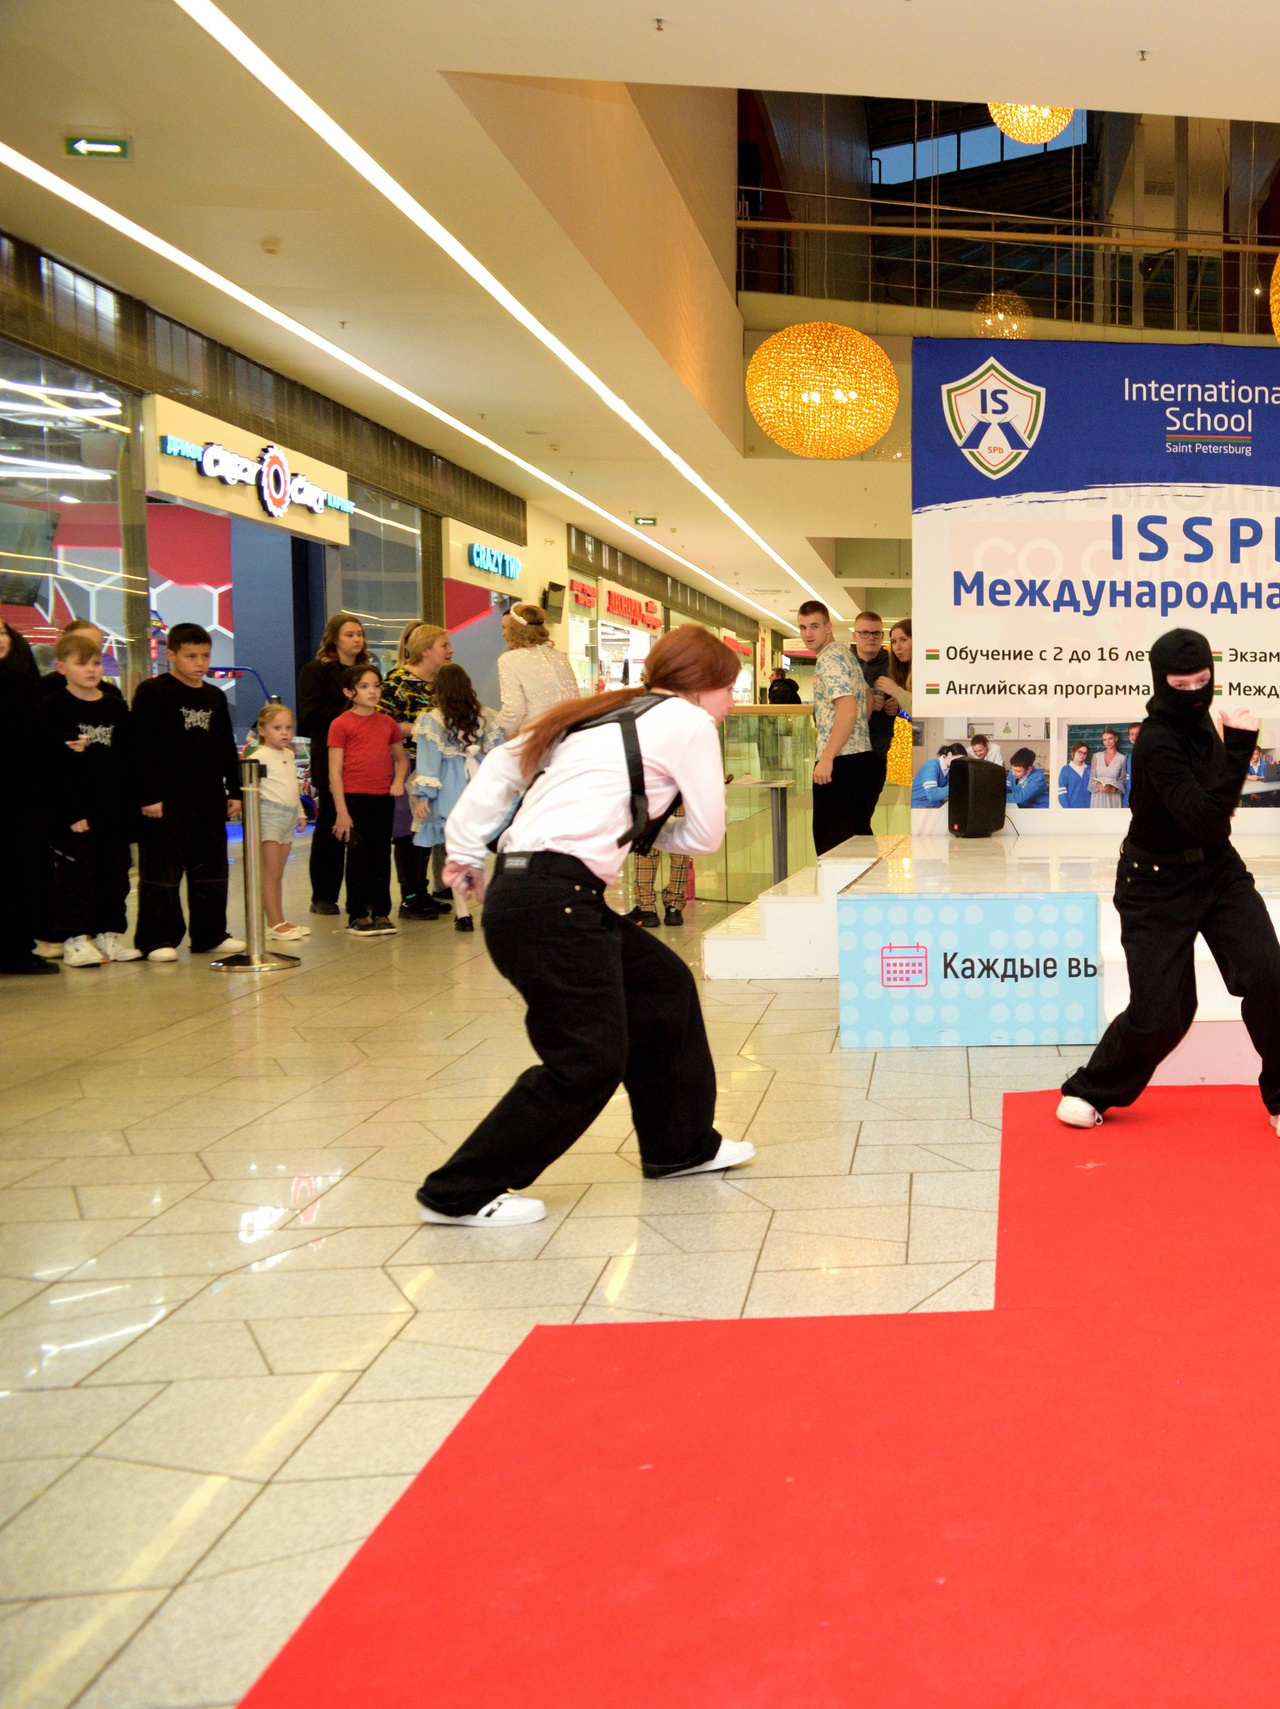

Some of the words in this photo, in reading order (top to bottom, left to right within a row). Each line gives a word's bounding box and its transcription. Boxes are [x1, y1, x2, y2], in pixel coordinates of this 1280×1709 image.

[980, 388, 1009, 415] IS
[1165, 407, 1252, 433] School
[987, 446, 1004, 454] SPb
[1165, 443, 1193, 454] Saint
[1195, 443, 1252, 457] Petersburg
[472, 543, 502, 573] CRAZY
[946, 646, 1034, 663] Обучение
[1039, 650, 1047, 660] с
[1053, 647, 1063, 661] 2
[1069, 649, 1091, 663] до
[1097, 647, 1119, 661] 16
[946, 679, 1048, 695] Английская
[1053, 683, 1151, 698] программа
[943, 952, 1058, 983] Каждые
